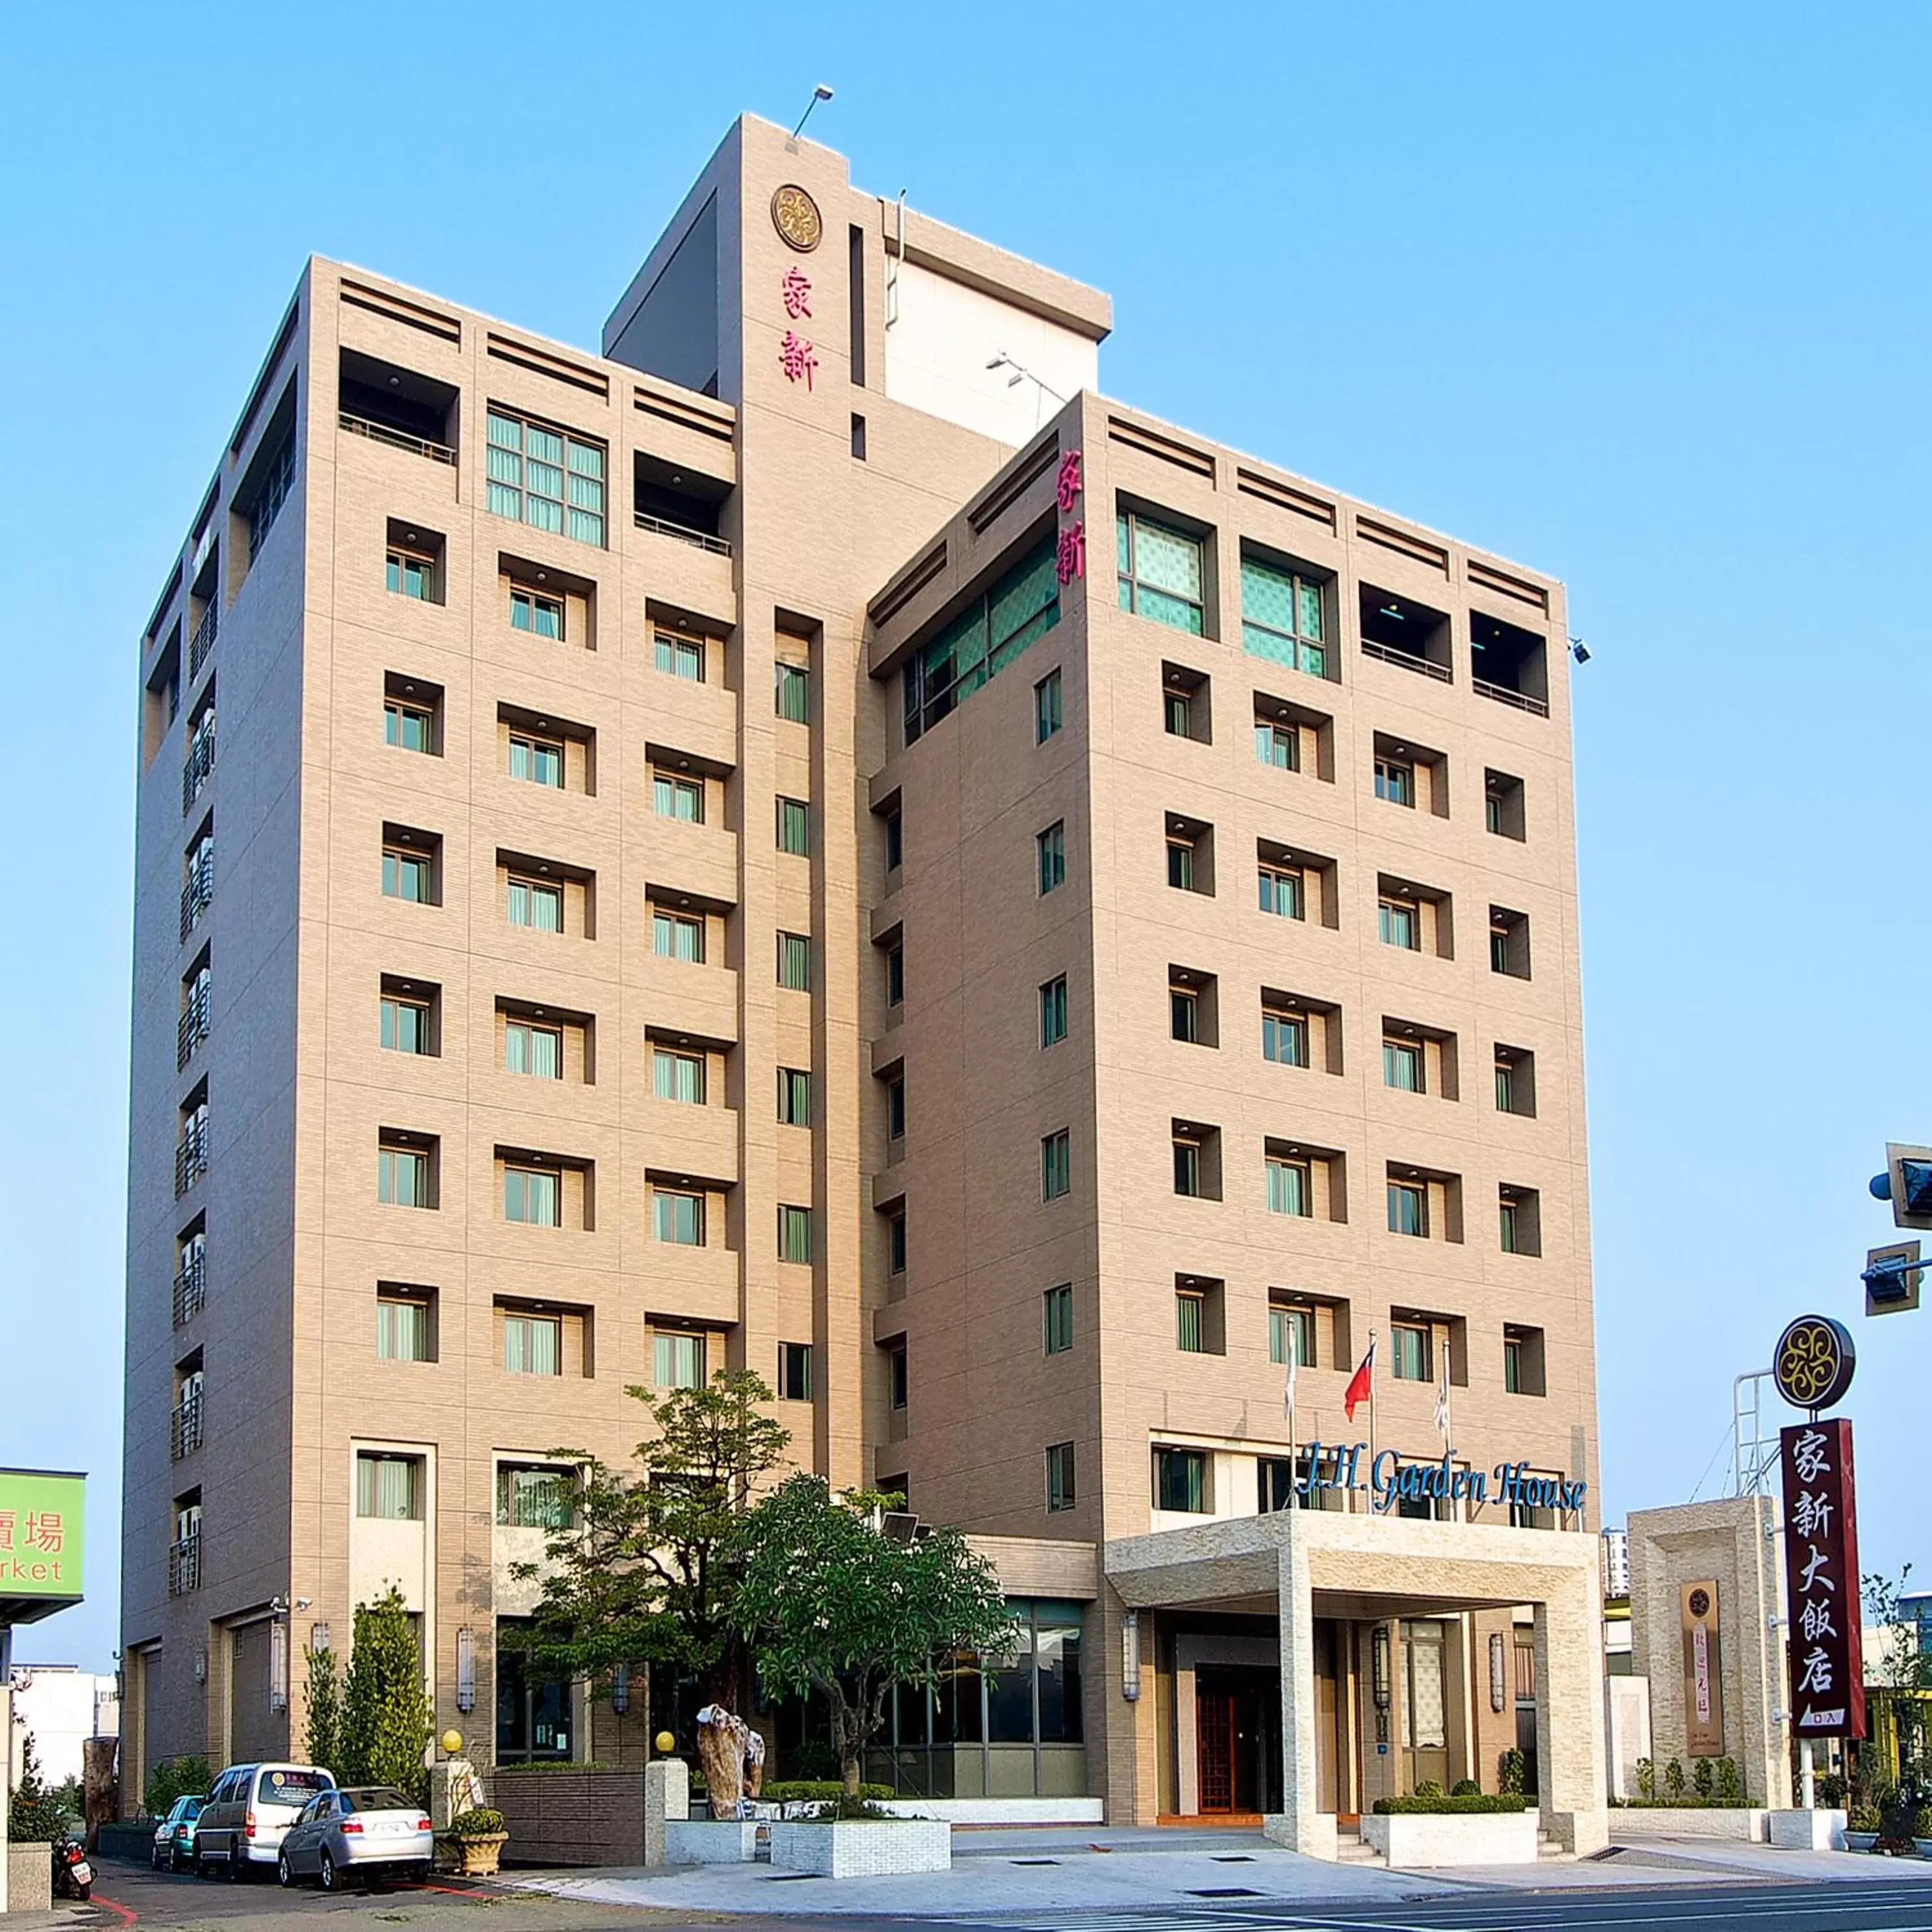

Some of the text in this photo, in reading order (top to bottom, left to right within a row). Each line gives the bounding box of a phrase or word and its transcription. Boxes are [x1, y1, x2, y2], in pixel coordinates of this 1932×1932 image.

[1372, 1448, 1487, 1511] Garden
[1494, 1461, 1587, 1509] House
[1792, 1429, 1837, 1693] 家新大飯店
